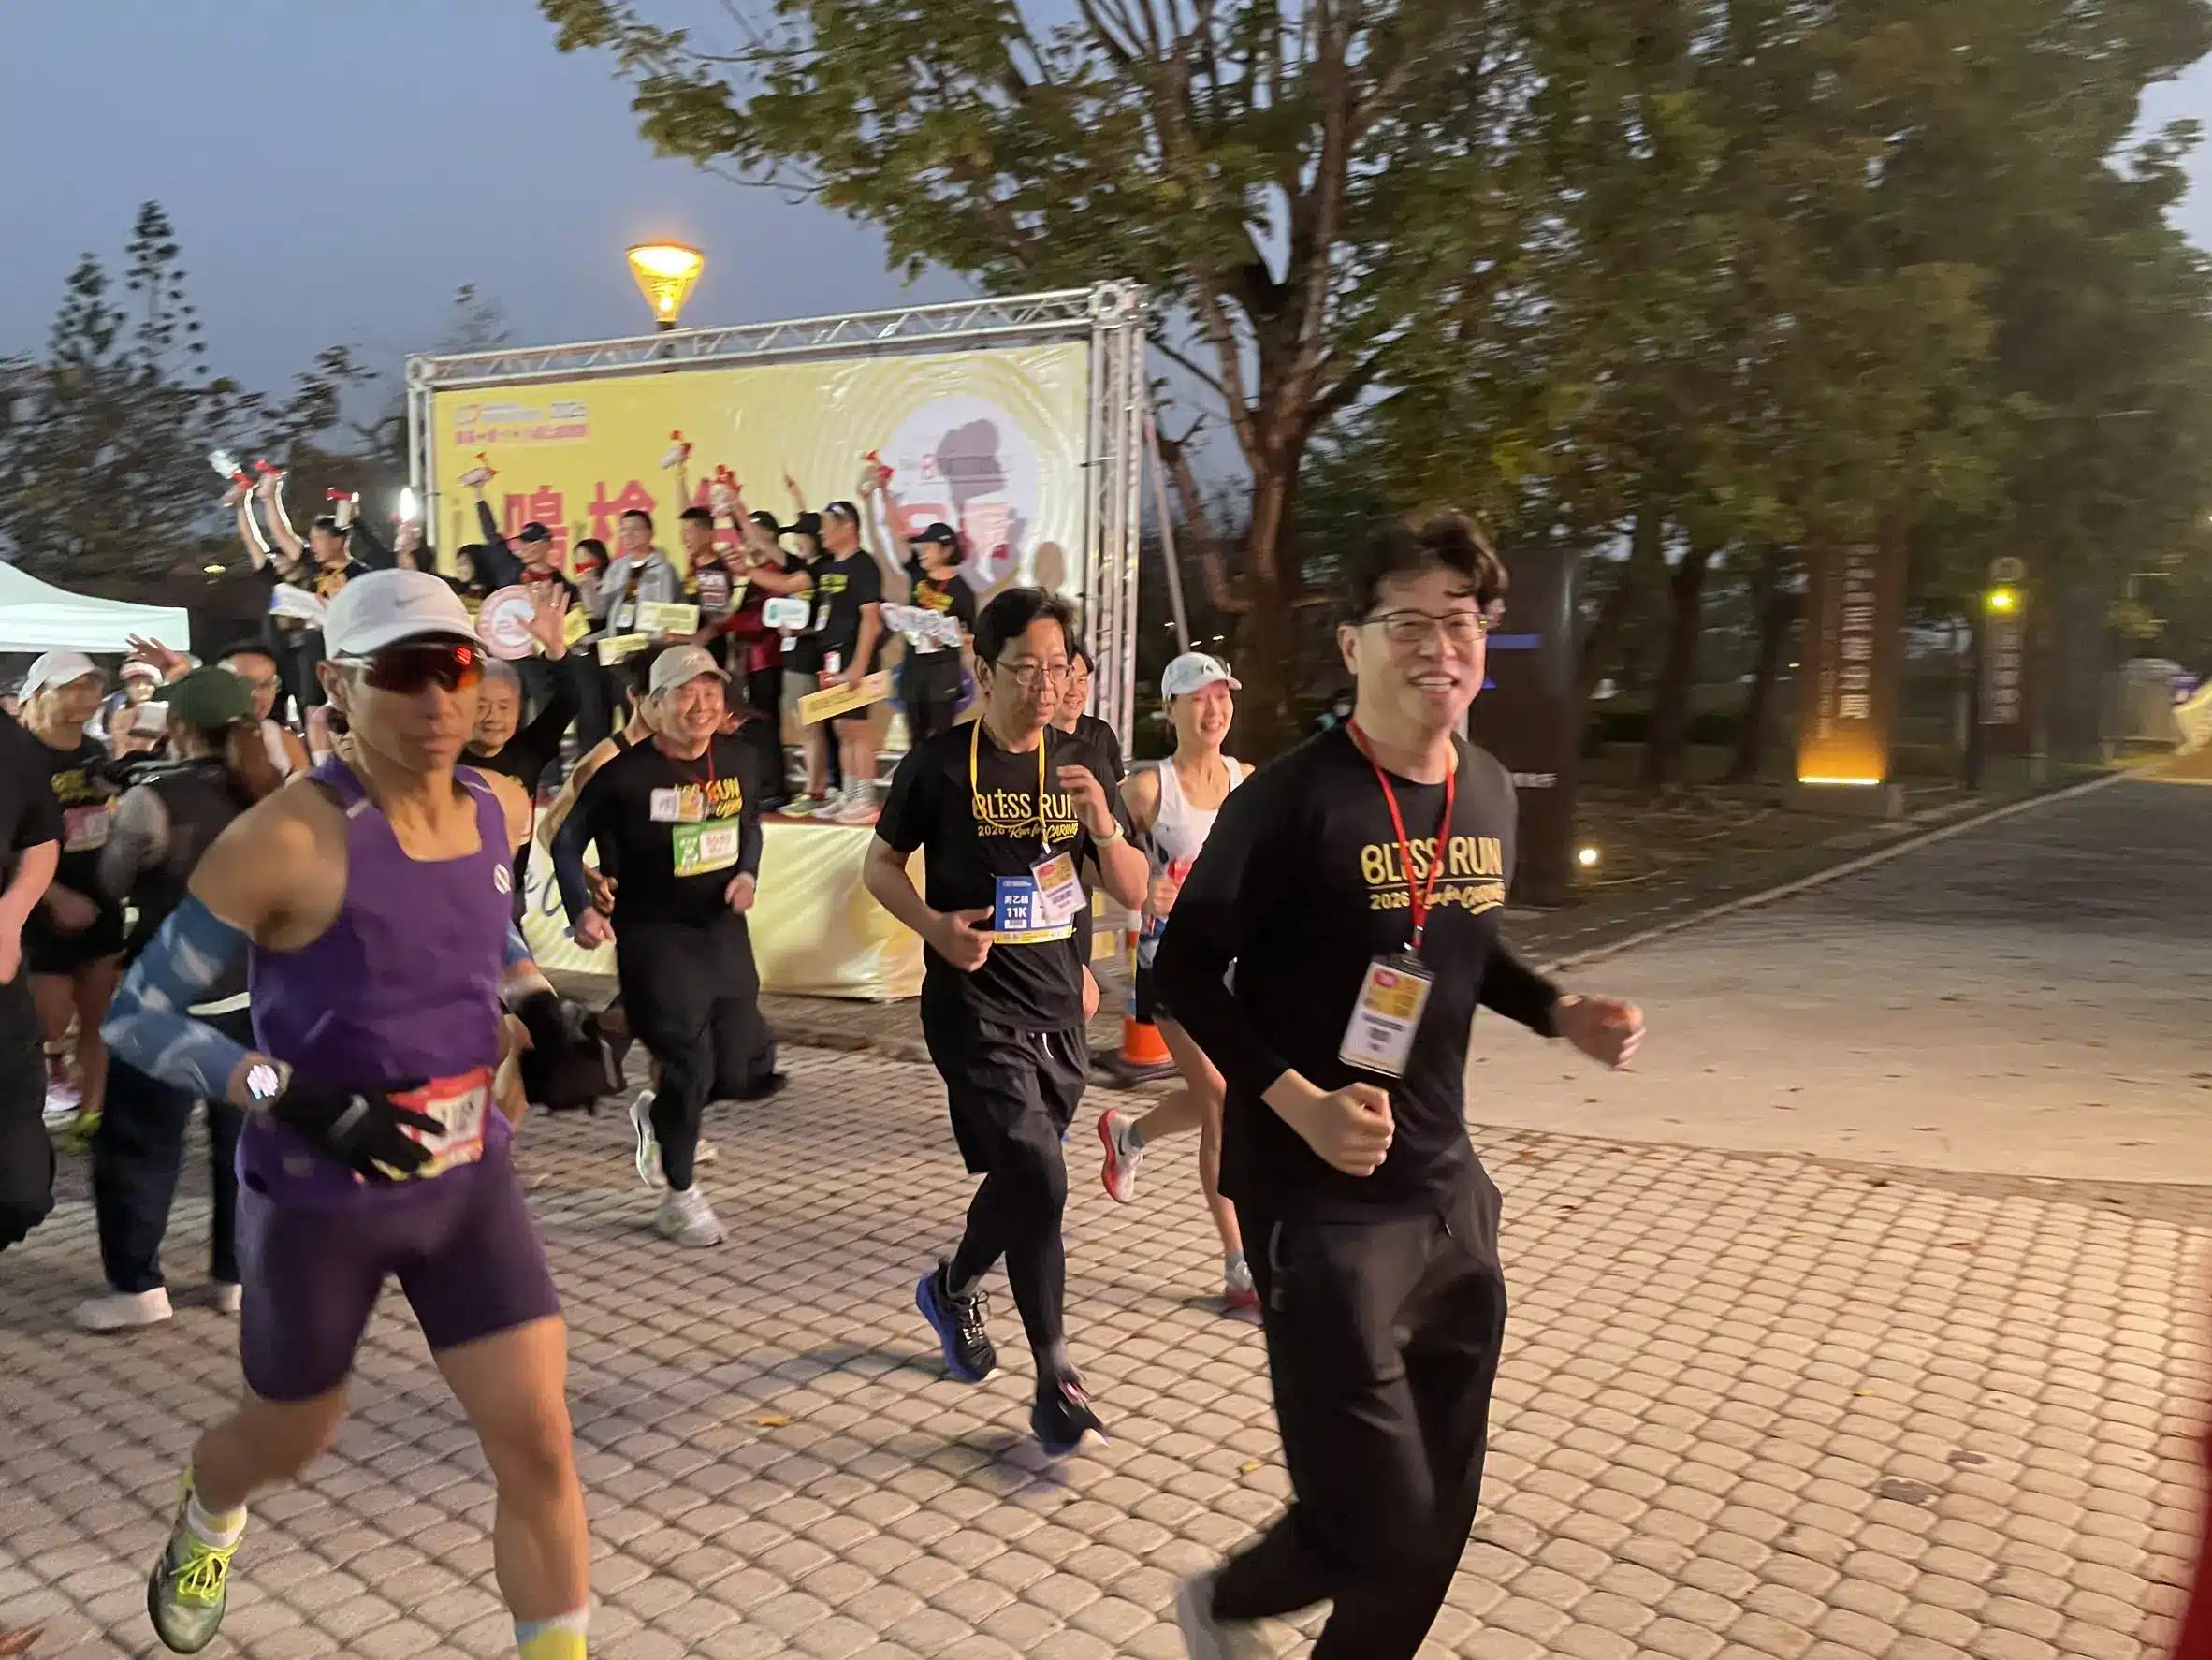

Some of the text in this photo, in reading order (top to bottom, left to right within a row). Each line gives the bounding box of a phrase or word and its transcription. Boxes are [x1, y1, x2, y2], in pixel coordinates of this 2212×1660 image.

[972, 788, 1032, 820] BLESS
[978, 824, 1006, 837] 2026
[1449, 836, 1503, 876] RUN
[1370, 891, 1410, 910] 2026
[1006, 907, 1027, 919] 11K
